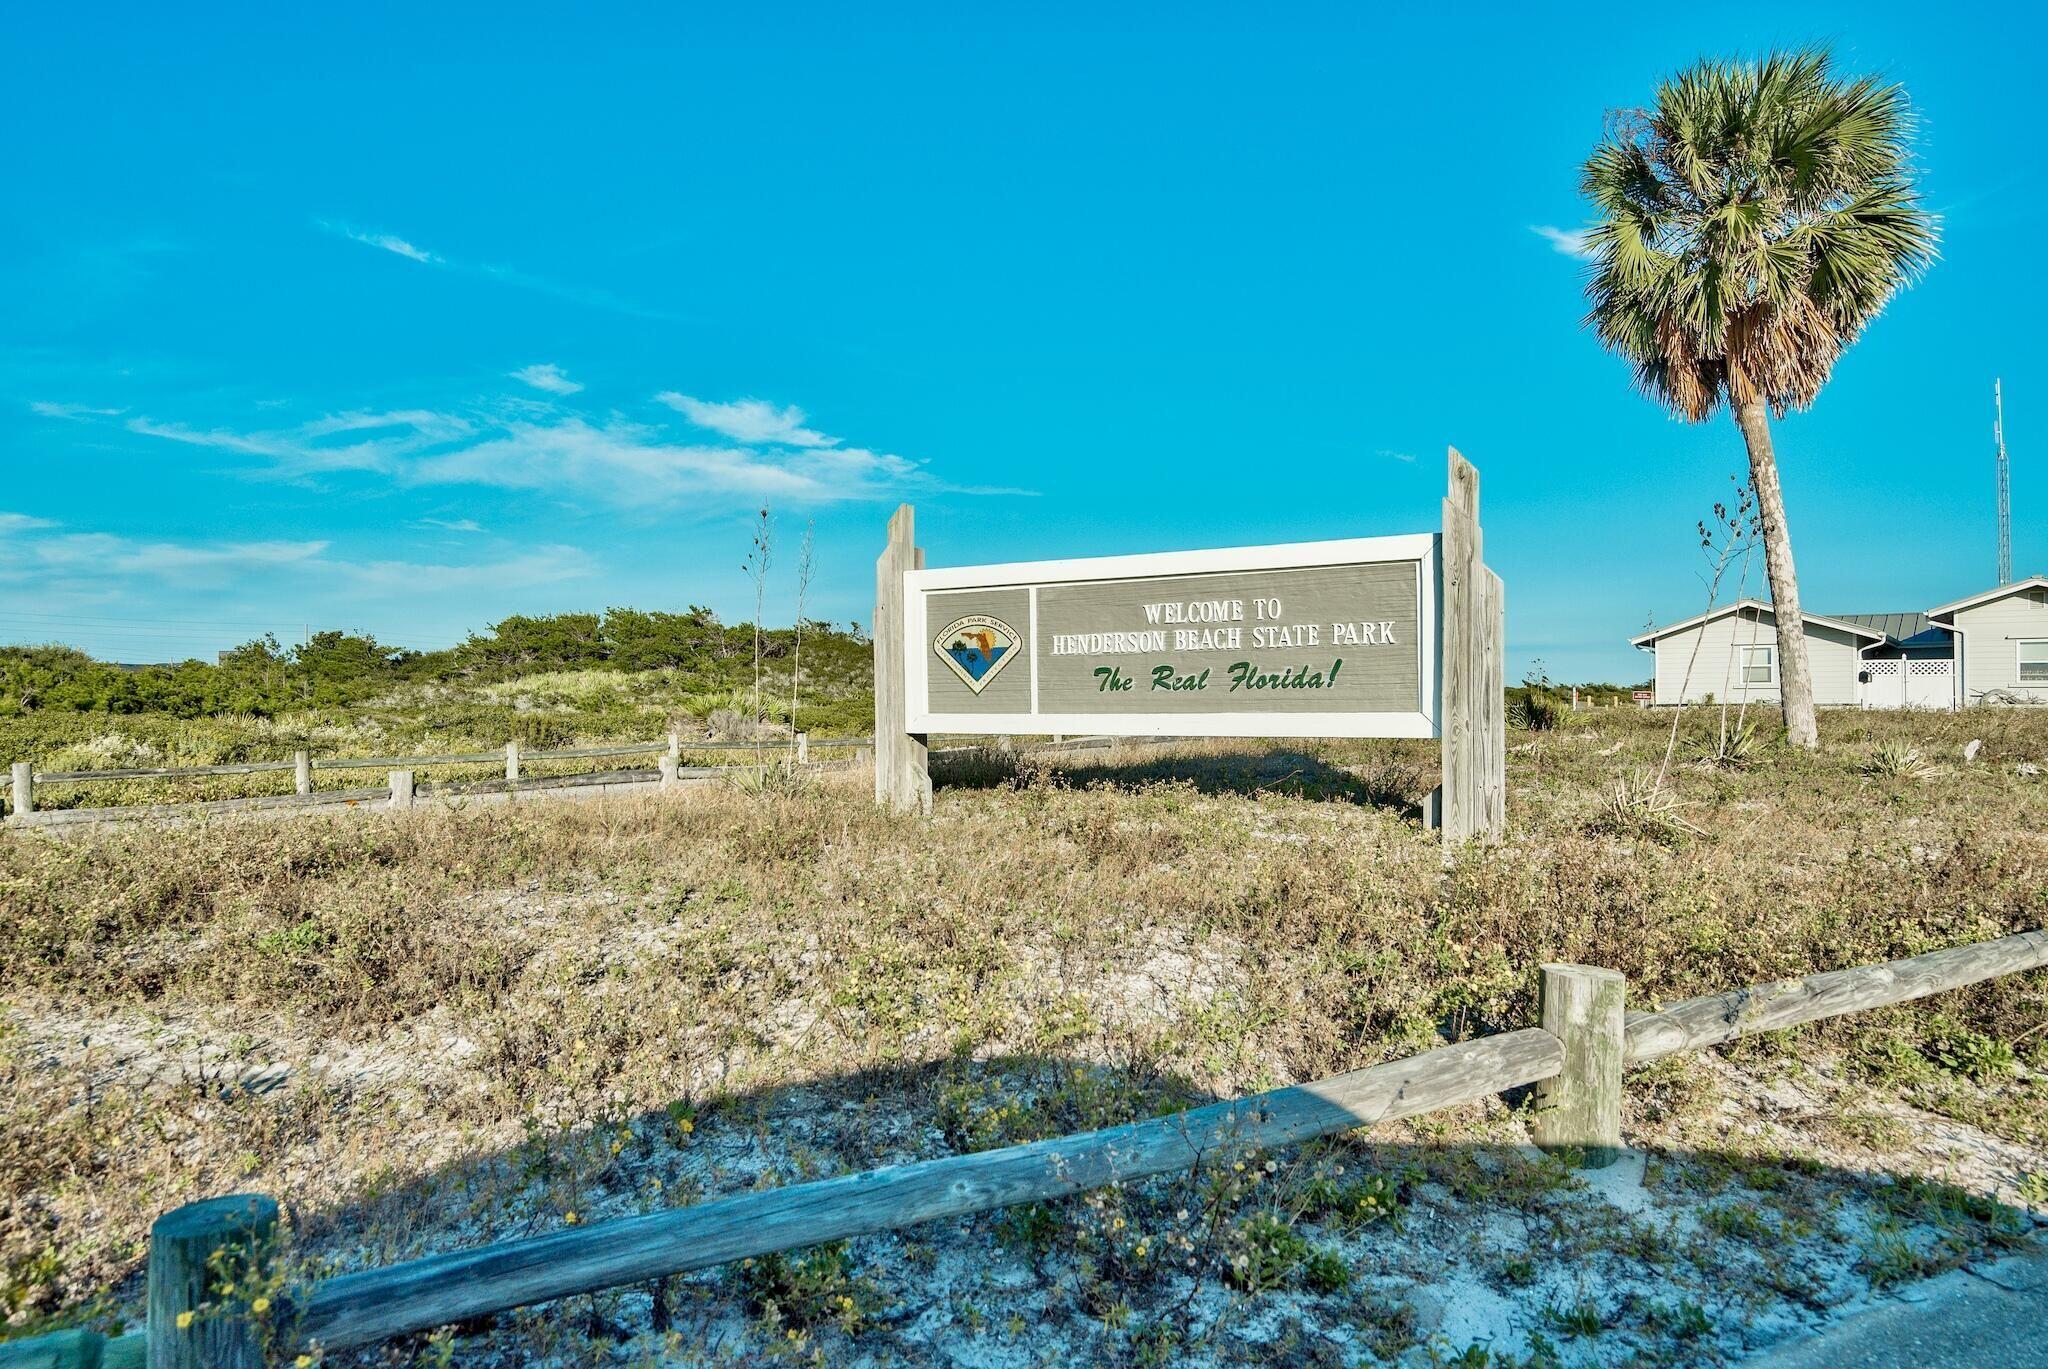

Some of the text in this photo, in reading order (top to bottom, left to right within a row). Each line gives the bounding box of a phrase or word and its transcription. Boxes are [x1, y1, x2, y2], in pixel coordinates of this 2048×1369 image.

[1143, 598, 1282, 624] WELCOME TO
[936, 621, 965, 644] FLORIDA
[990, 619, 1018, 641] SERVICE
[1052, 621, 1396, 655] HENDERSON BEACH STATE PARK
[1093, 658, 1343, 692] The Real Florida!
